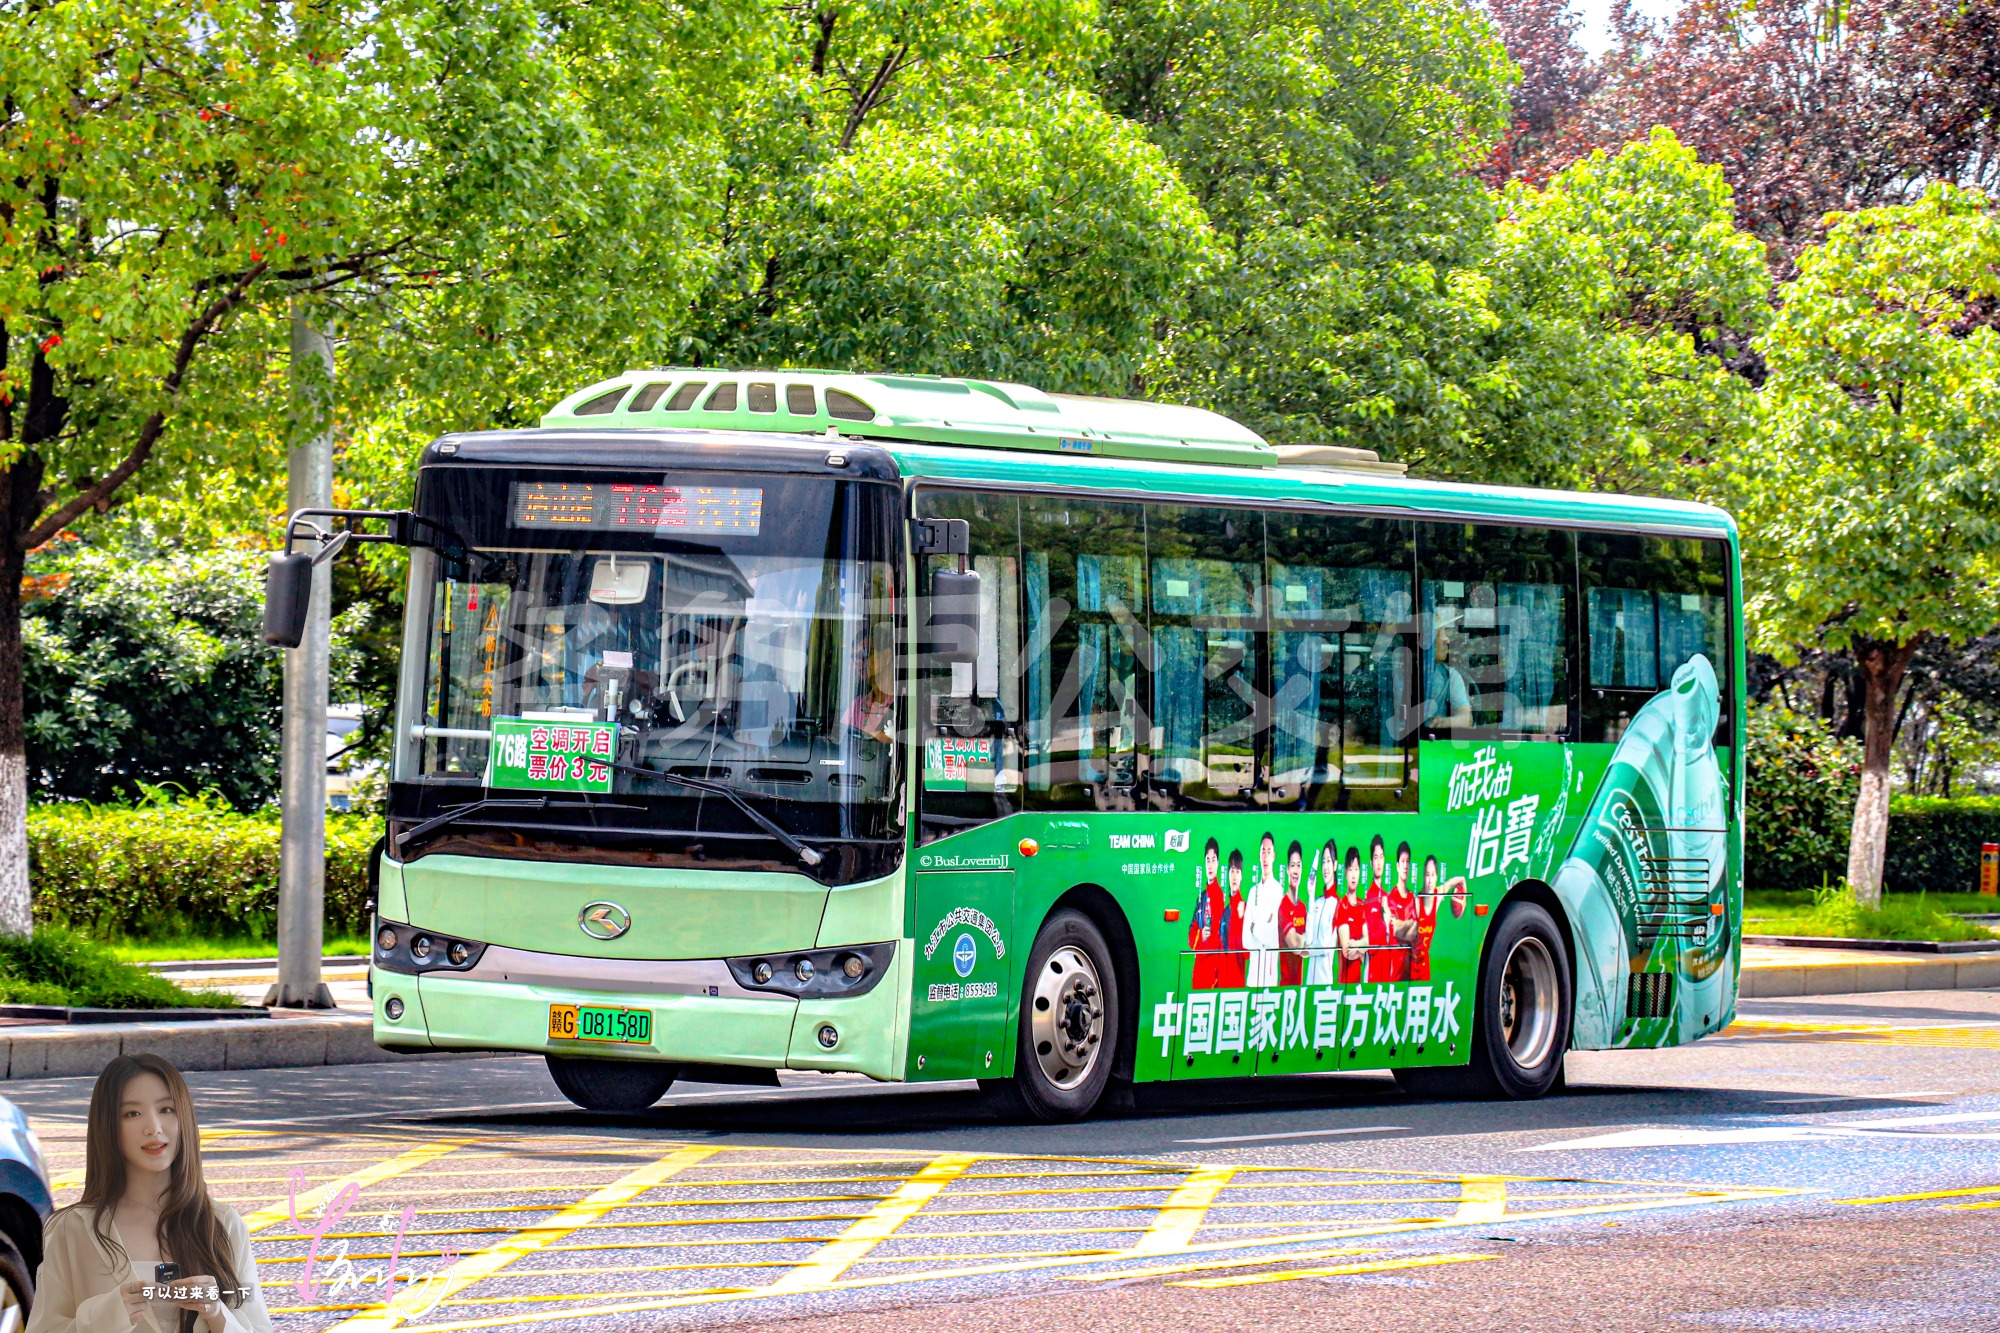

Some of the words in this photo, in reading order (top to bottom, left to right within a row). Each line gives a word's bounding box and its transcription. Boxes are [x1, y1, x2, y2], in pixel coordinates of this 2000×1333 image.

[496, 733, 528, 769] 76路
[528, 754, 609, 783] 票价3元
[530, 727, 611, 765] 空调开启
[1447, 745, 1514, 812] 你我的
[1109, 834, 1131, 849] TEAM
[1131, 833, 1156, 849] CHINA
[1465, 794, 1540, 880] 怡寶
[1614, 855, 1637, 904] Drinking
[924, 907, 1006, 961] 九江市公共交通集团公司
[1151, 981, 1462, 1058] 中国国家队官方饮用水
